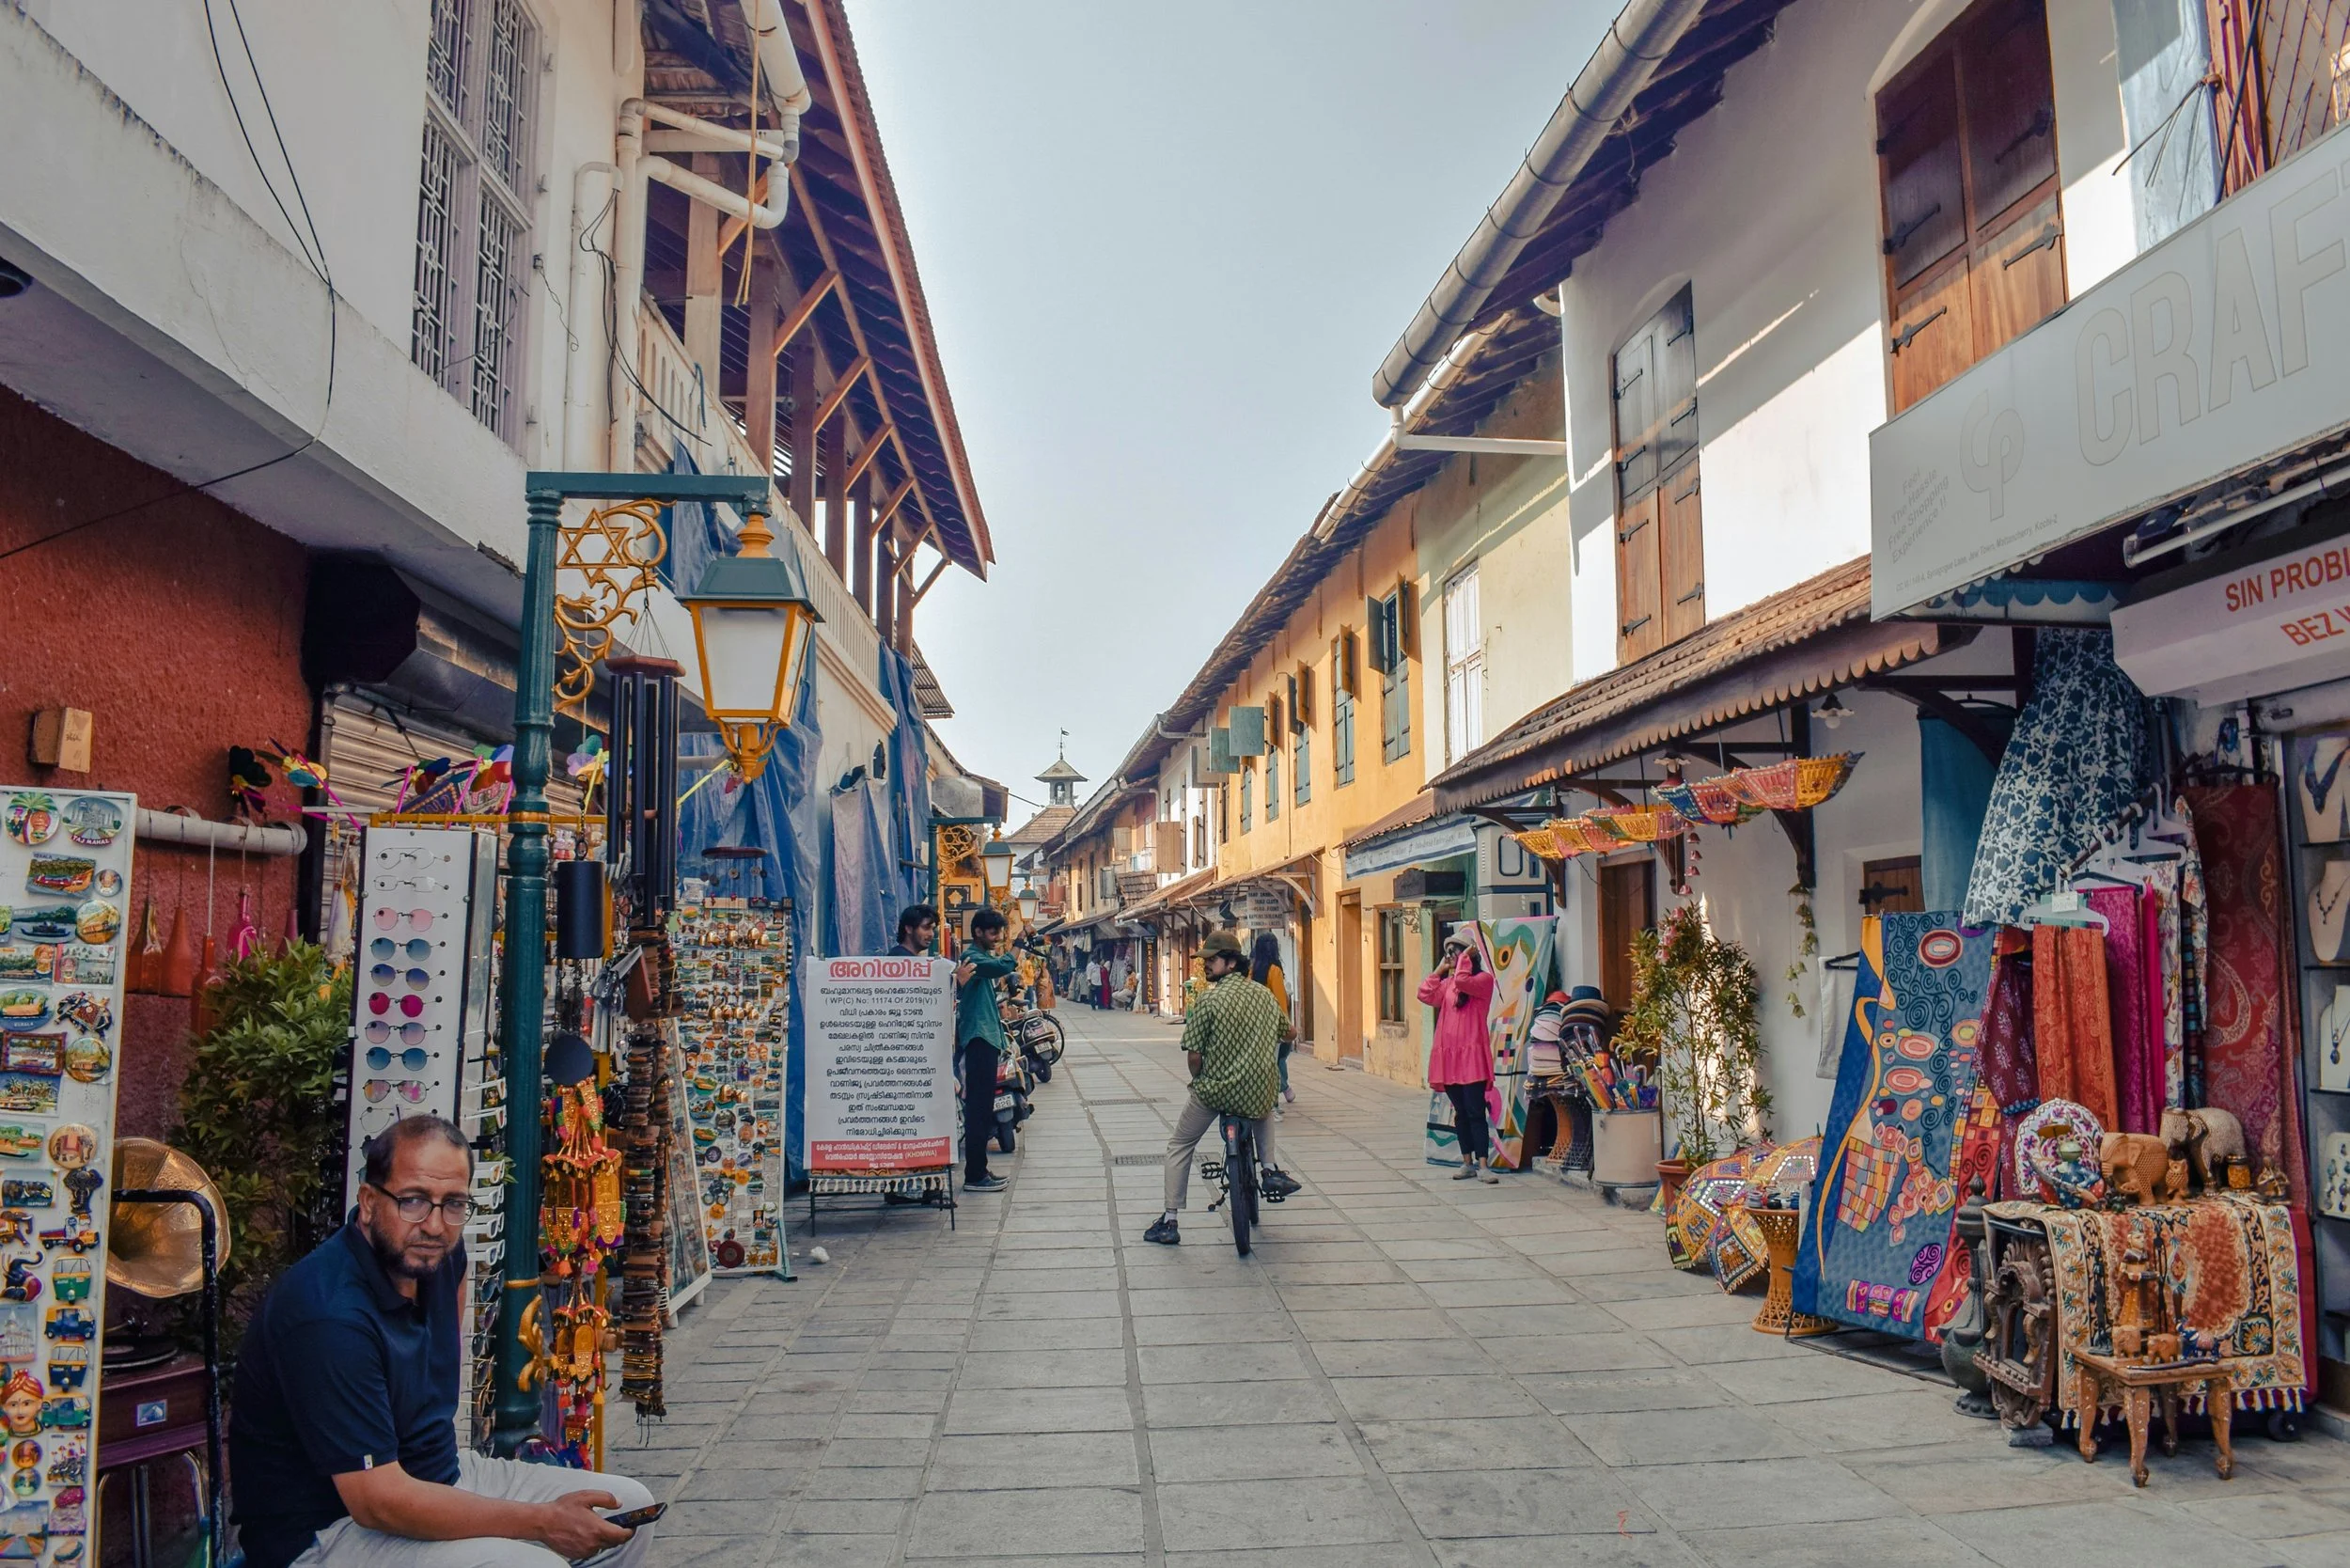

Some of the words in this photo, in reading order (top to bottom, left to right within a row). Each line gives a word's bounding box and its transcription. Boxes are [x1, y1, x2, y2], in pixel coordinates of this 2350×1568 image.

[2074, 158, 2350, 466] CRAF
[1908, 476, 1950, 526] Shopping
[2225, 574, 2264, 612] SIN
[2280, 612, 2345, 646] BEZ
[72, 835, 86, 844] TAJ
[829, 958, 934, 978] അറിയിപ്പ്
